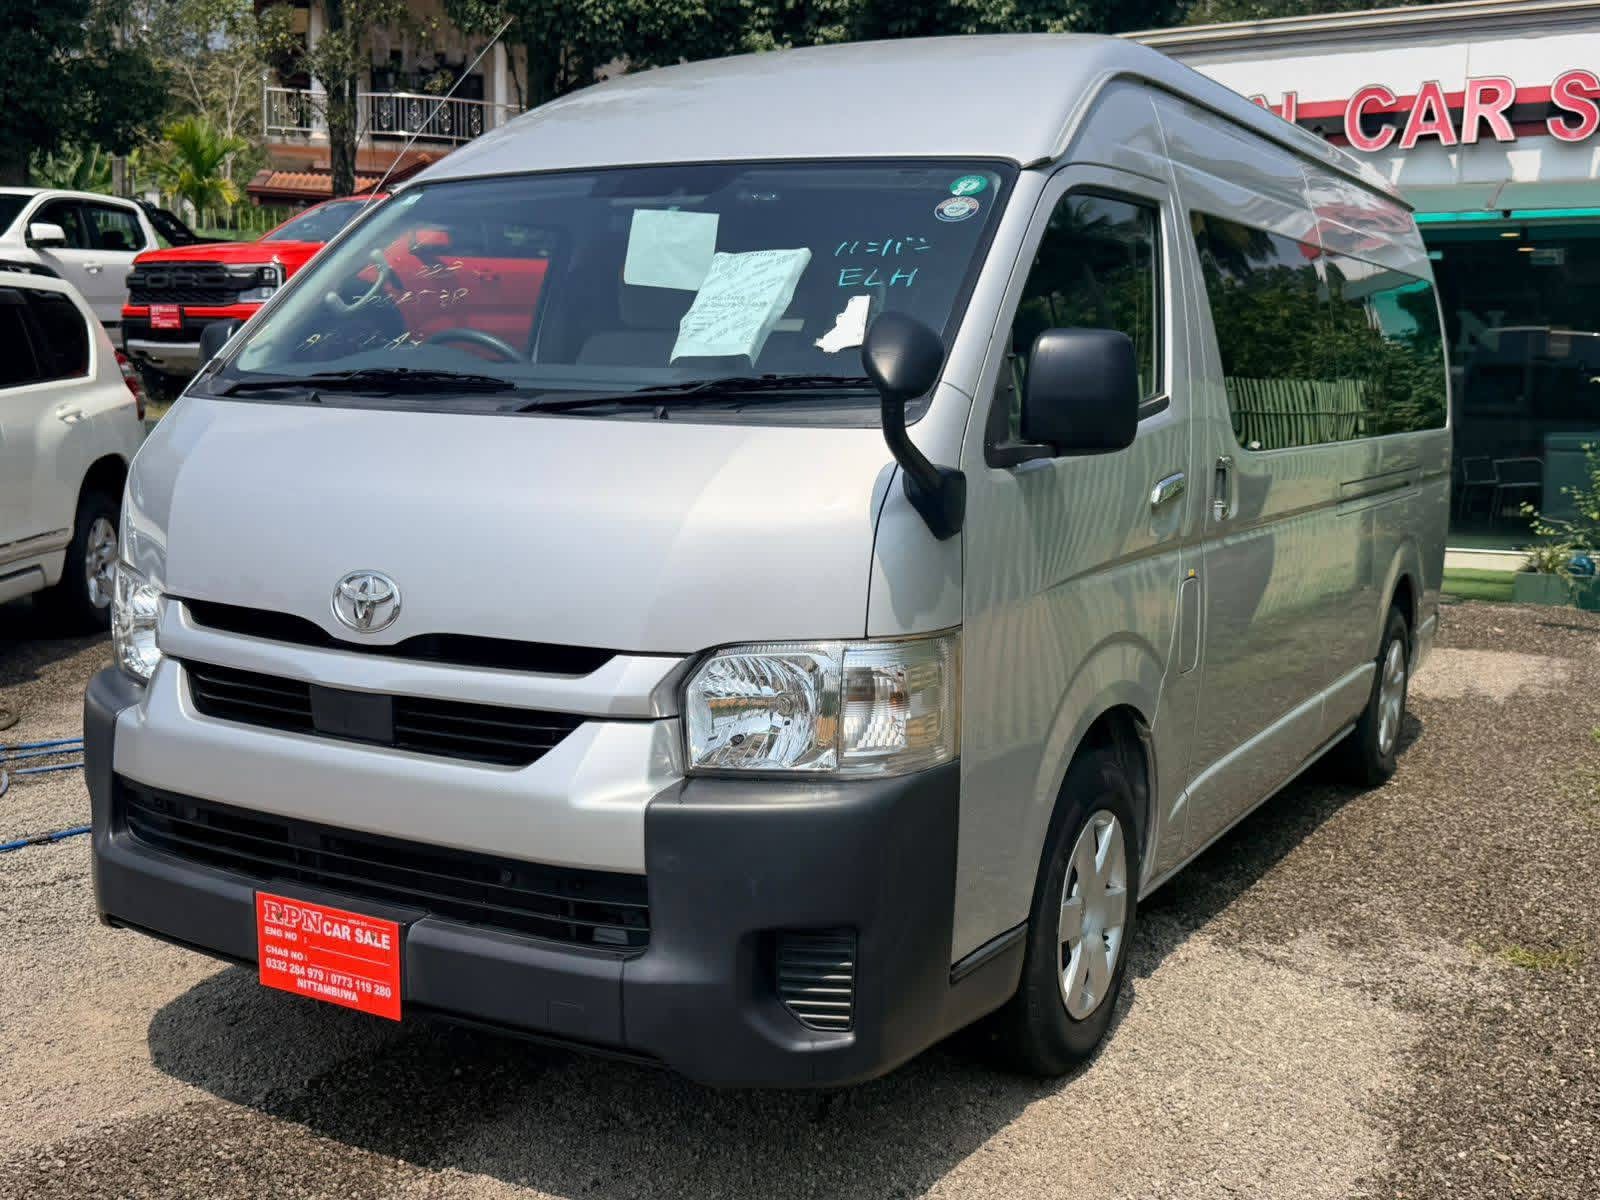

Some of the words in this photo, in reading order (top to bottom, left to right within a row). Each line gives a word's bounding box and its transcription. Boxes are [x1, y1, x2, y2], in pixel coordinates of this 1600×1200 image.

[1344, 75, 1516, 152] CAR
[264, 900, 323, 934] RPN
[264, 926, 283, 937] ENG
[285, 930, 298, 941] NO
[323, 921, 351, 941] CAR
[355, 928, 391, 950] SALE
[265, 944, 289, 958] CHAS
[265, 957, 288, 972] 0332
[289, 963, 306, 977] 284
[307, 967, 324, 982] 979
[330, 973, 353, 989] 0773
[355, 979, 373, 993] 119
[373, 984, 392, 999] 280
[297, 977, 359, 1003] NITTAMBUWA
